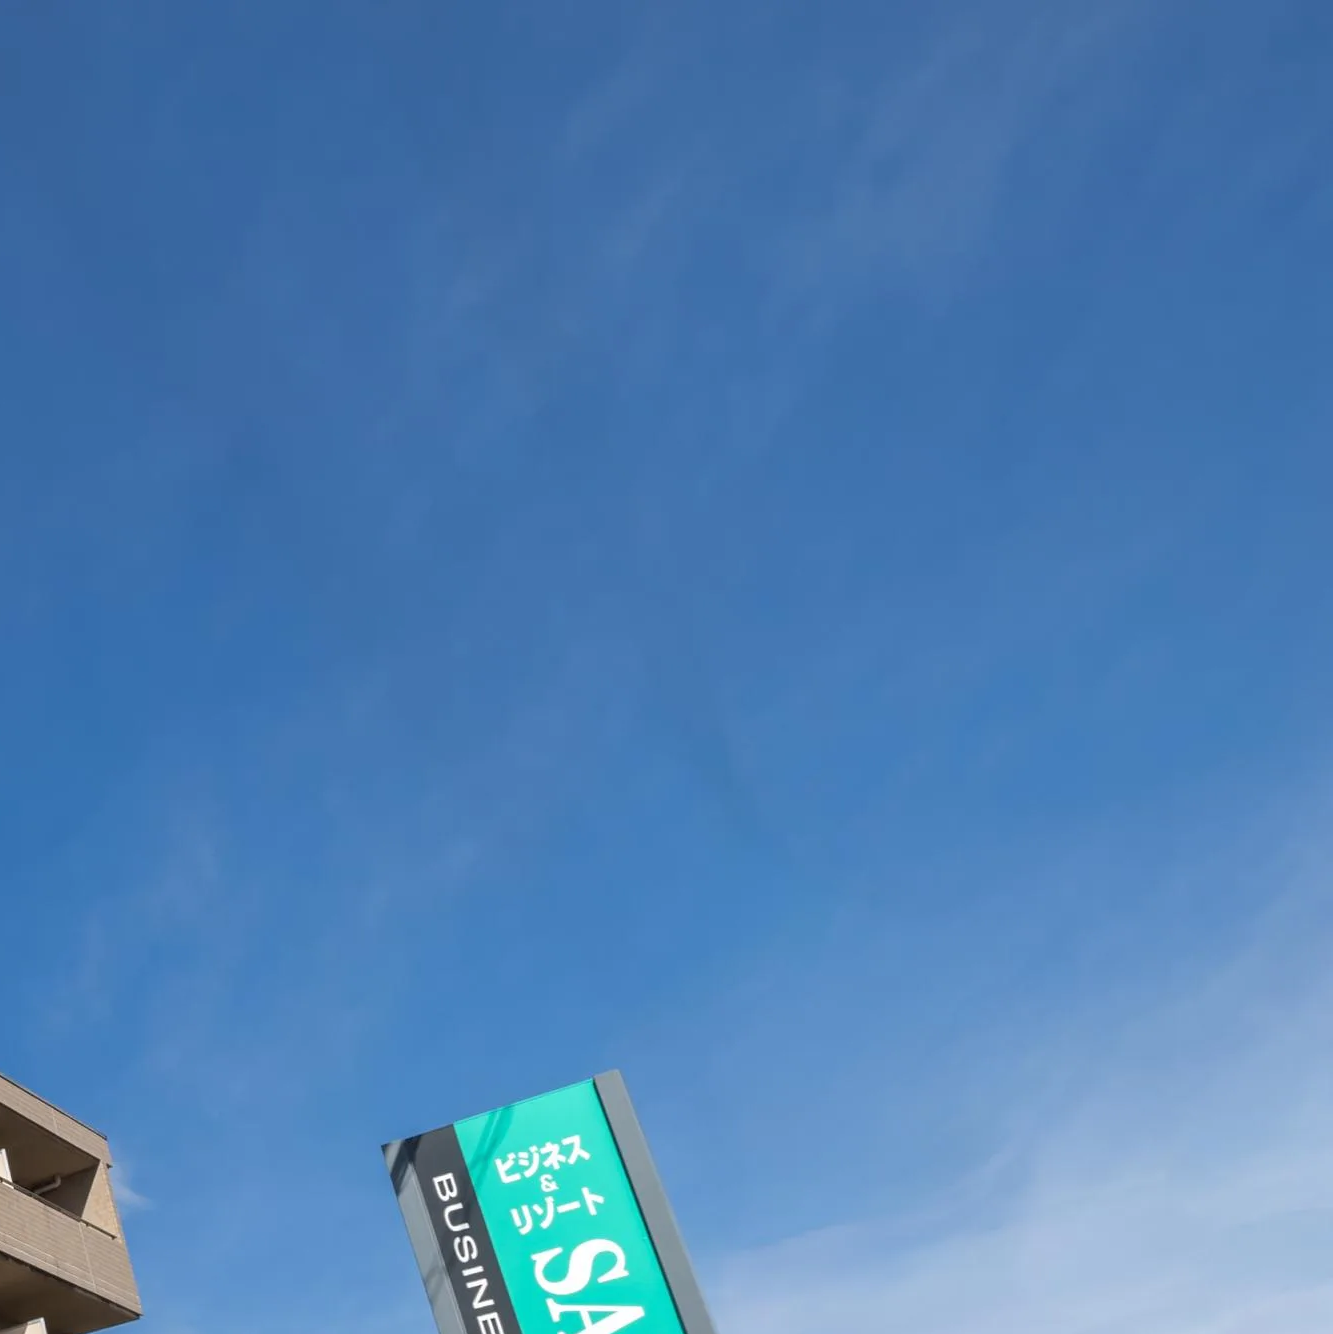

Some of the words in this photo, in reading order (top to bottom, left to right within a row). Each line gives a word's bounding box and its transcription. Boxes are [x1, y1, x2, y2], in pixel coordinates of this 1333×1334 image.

[495, 1135, 591, 1184] ビジネス
[540, 1173, 559, 1193] &
